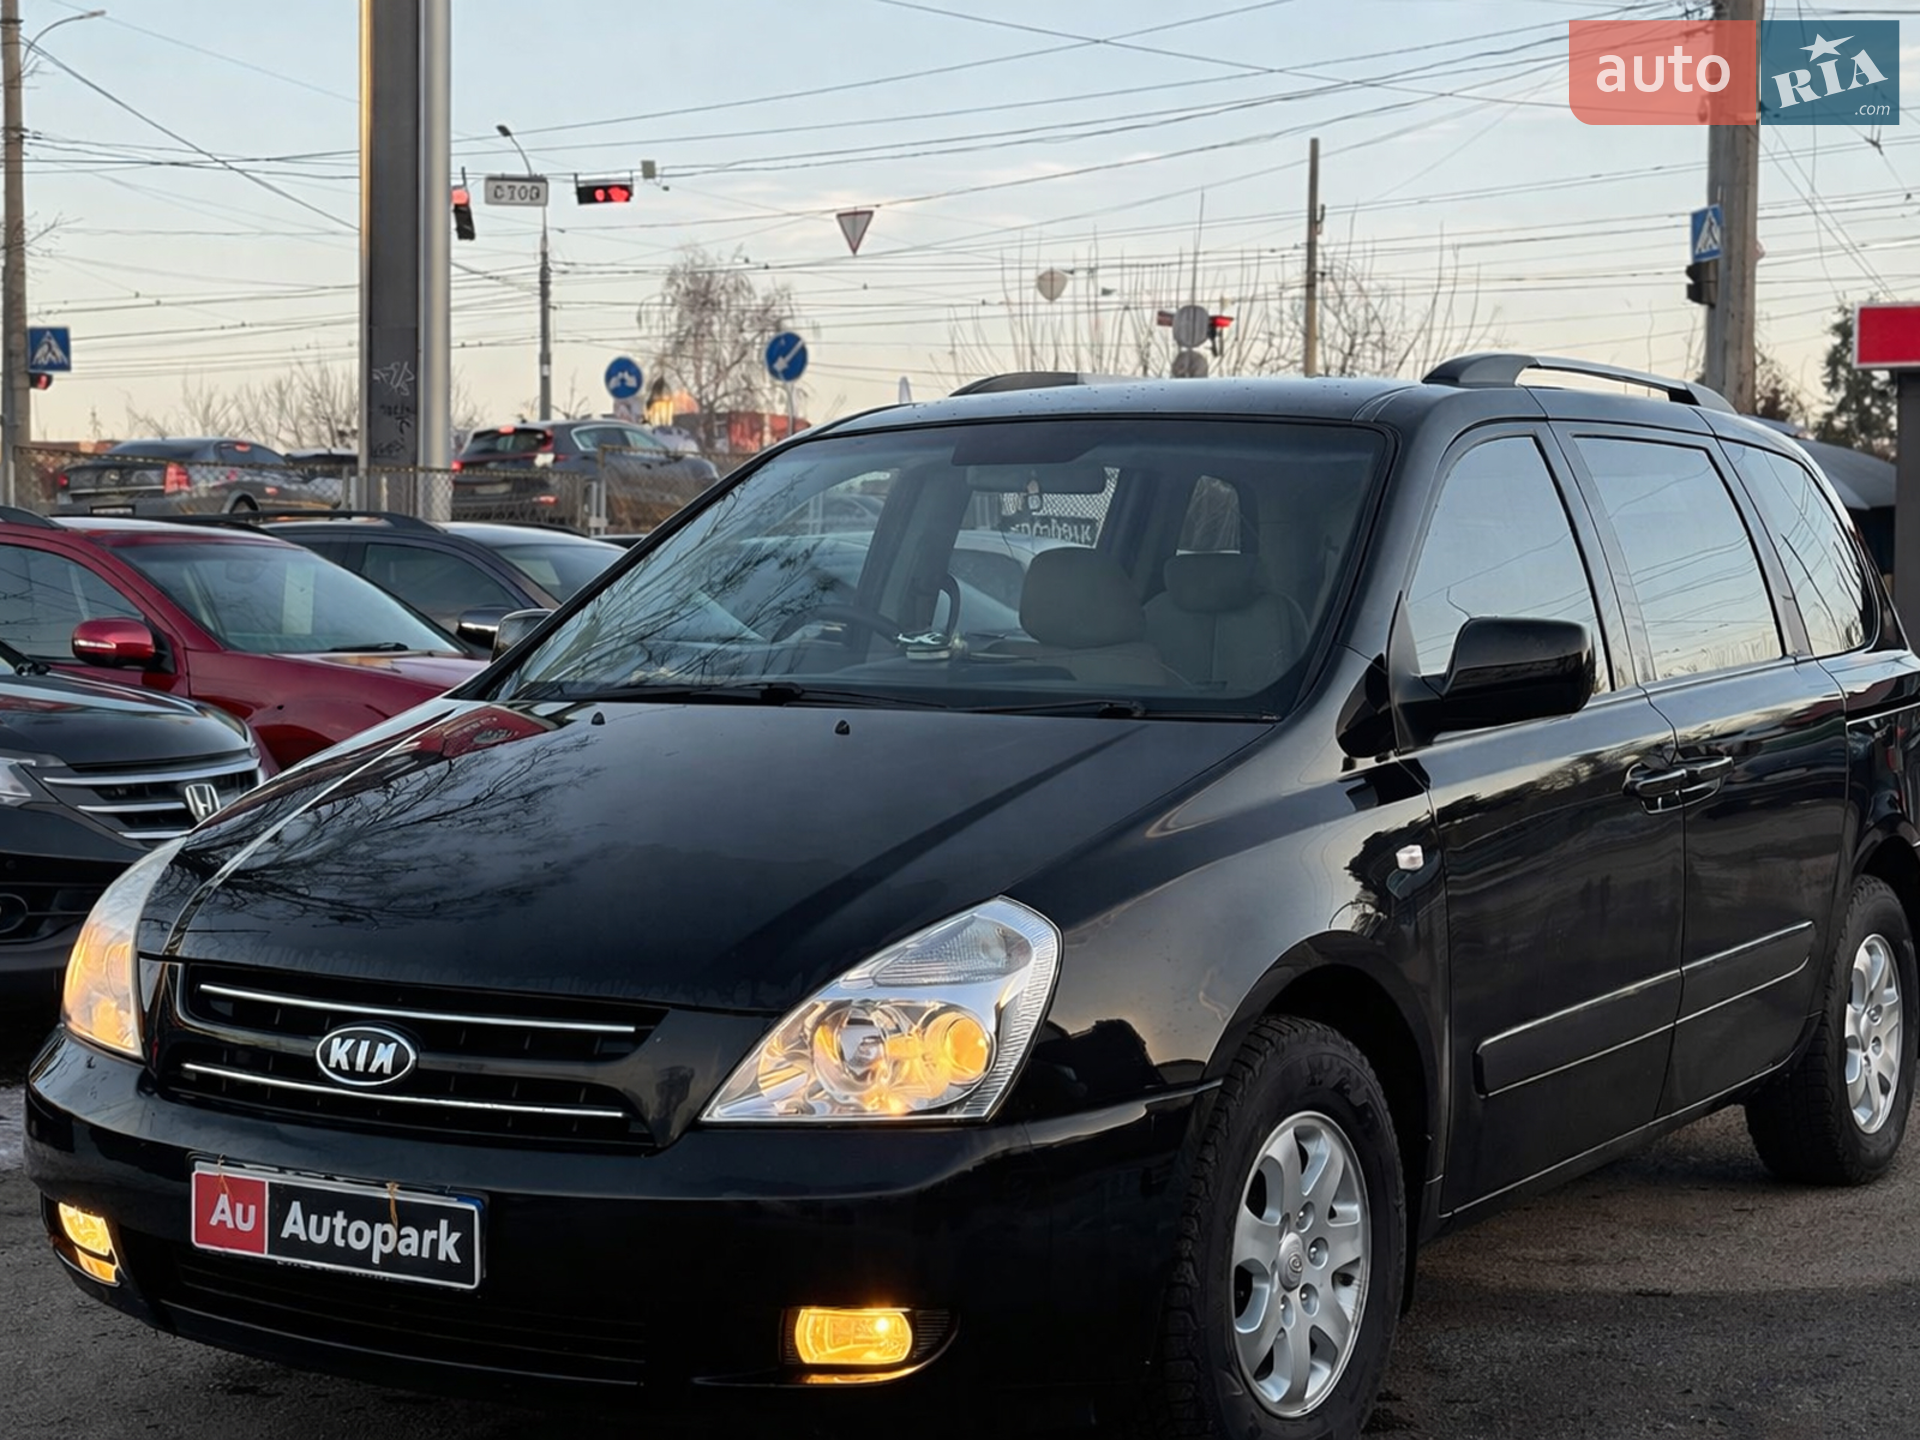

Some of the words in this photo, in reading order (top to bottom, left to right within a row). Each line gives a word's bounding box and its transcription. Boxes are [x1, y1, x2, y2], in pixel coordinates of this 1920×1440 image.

[328, 1037, 398, 1075] KIA
[209, 1193, 256, 1232] Au
[280, 1200, 463, 1264] Autopark
